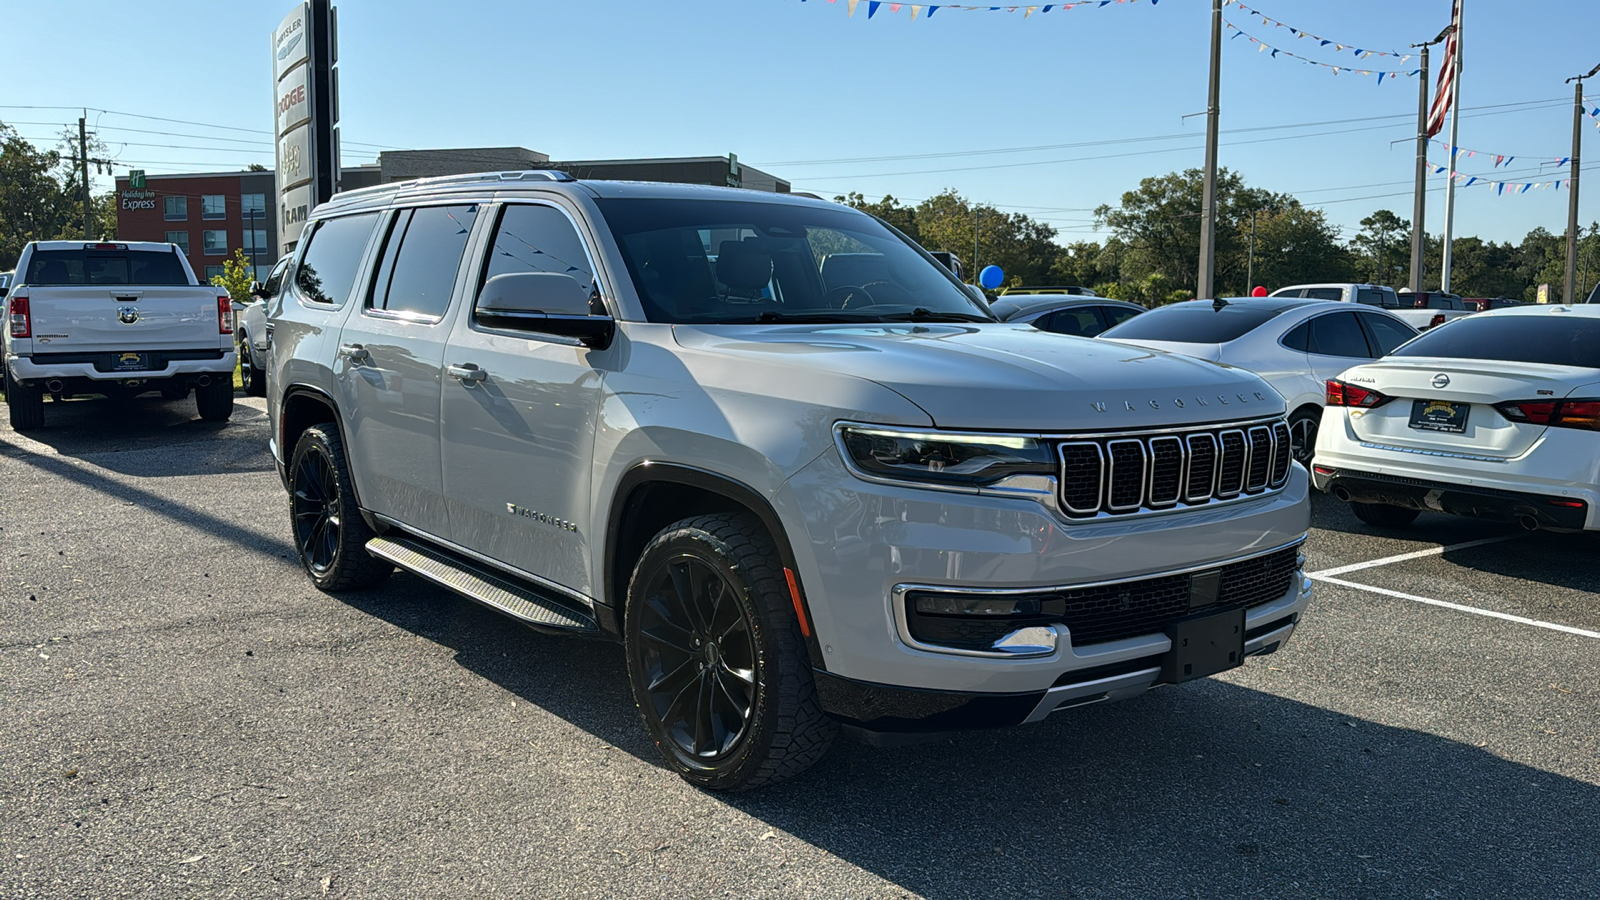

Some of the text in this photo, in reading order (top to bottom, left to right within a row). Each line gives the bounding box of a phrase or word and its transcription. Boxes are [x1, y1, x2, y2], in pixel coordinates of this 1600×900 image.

[277, 18, 302, 48] HRYSLER
[121, 189, 156, 200] Holiday Inn
[122, 199, 156, 211] Express
[285, 204, 308, 226] RAM
[1090, 391, 1266, 413] WAGONEER
[517, 505, 577, 533] WAGONEER
